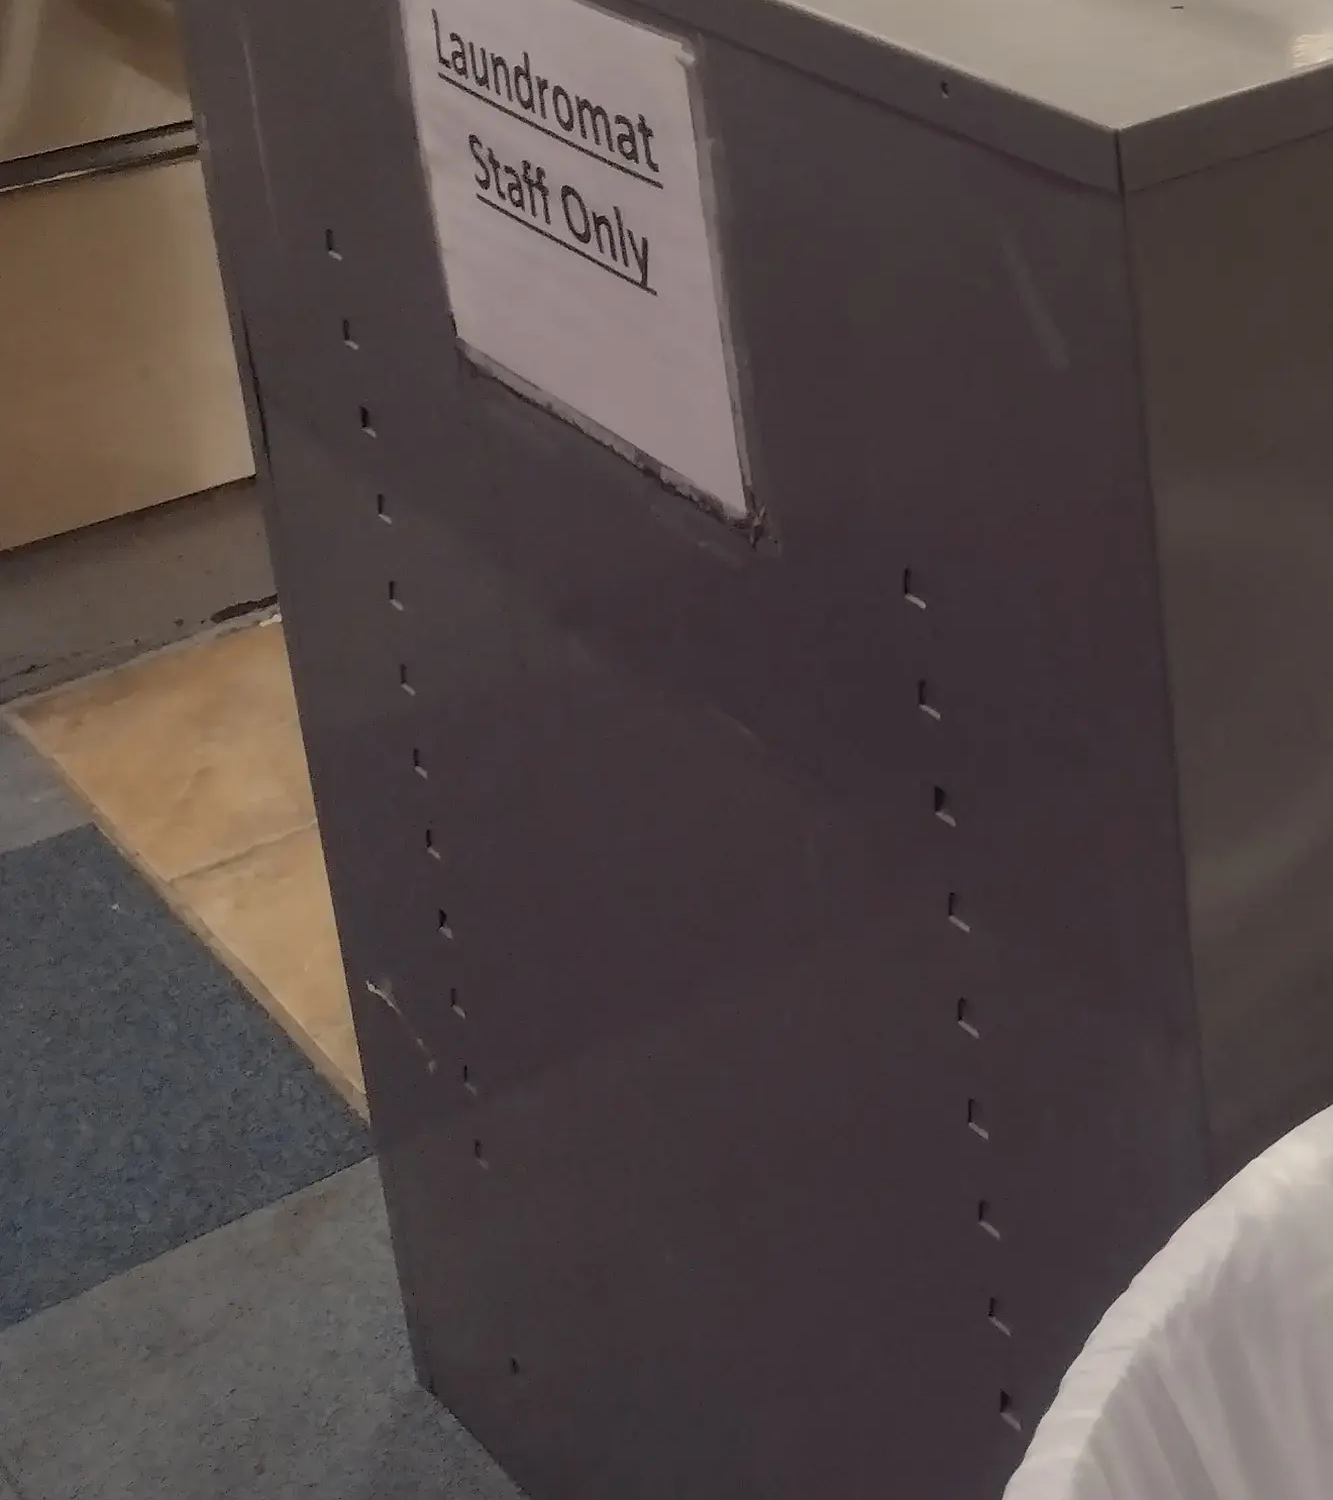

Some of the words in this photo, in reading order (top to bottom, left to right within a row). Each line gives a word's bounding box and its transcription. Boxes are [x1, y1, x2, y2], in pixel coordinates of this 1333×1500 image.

[431, 8, 660, 173] Laundromat
[468, 133, 551, 225] Staff
[560, 184, 650, 286] Only
